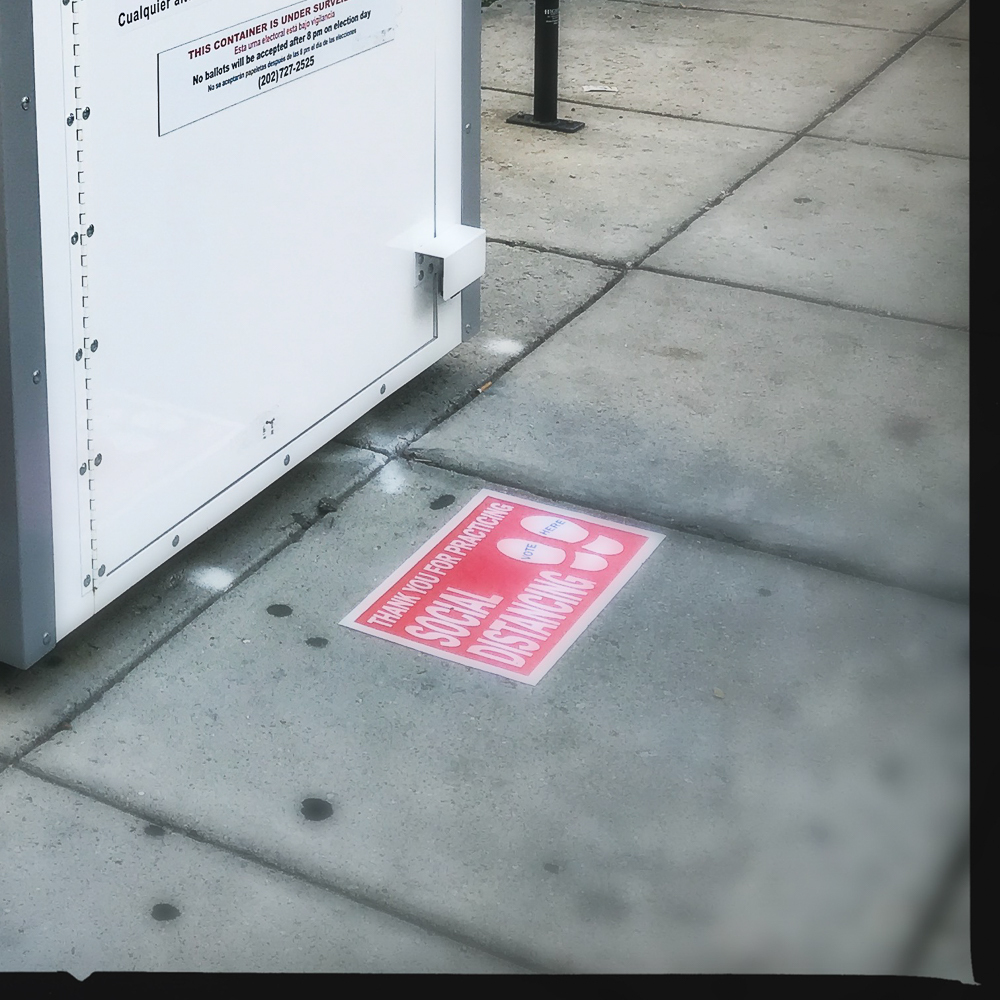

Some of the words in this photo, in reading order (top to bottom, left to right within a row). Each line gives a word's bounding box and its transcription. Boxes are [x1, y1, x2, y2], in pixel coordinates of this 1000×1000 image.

[188, 44, 211, 59] THIS
[214, 23, 267, 50] CONTAINER
[270, 19, 278, 29] IS
[281, 7, 311, 24] UNDER
[193, 75, 203, 85] No
[205, 64, 229, 80] ballots
[232, 57, 244, 70] will
[246, 55, 254, 64] be
[257, 40, 288, 60] accepted
[290, 34, 306, 47] after
[307, 31, 311, 40] 8
[313, 29, 322, 40] pm
[324, 25, 332, 33] on
[334, 16, 359, 30] election
[360, 10, 371, 20] day
[441, 501, 515, 559] PRACTICING
[521, 543, 538, 561] VOTE
[539, 518, 566, 536] HERE
[405, 572, 439, 597] YOU
[425, 552, 462, 576] FOR
[367, 591, 421, 628] THANK
[404, 587, 504, 647] SOCIAL
[466, 570, 597, 668] DISTANCING
